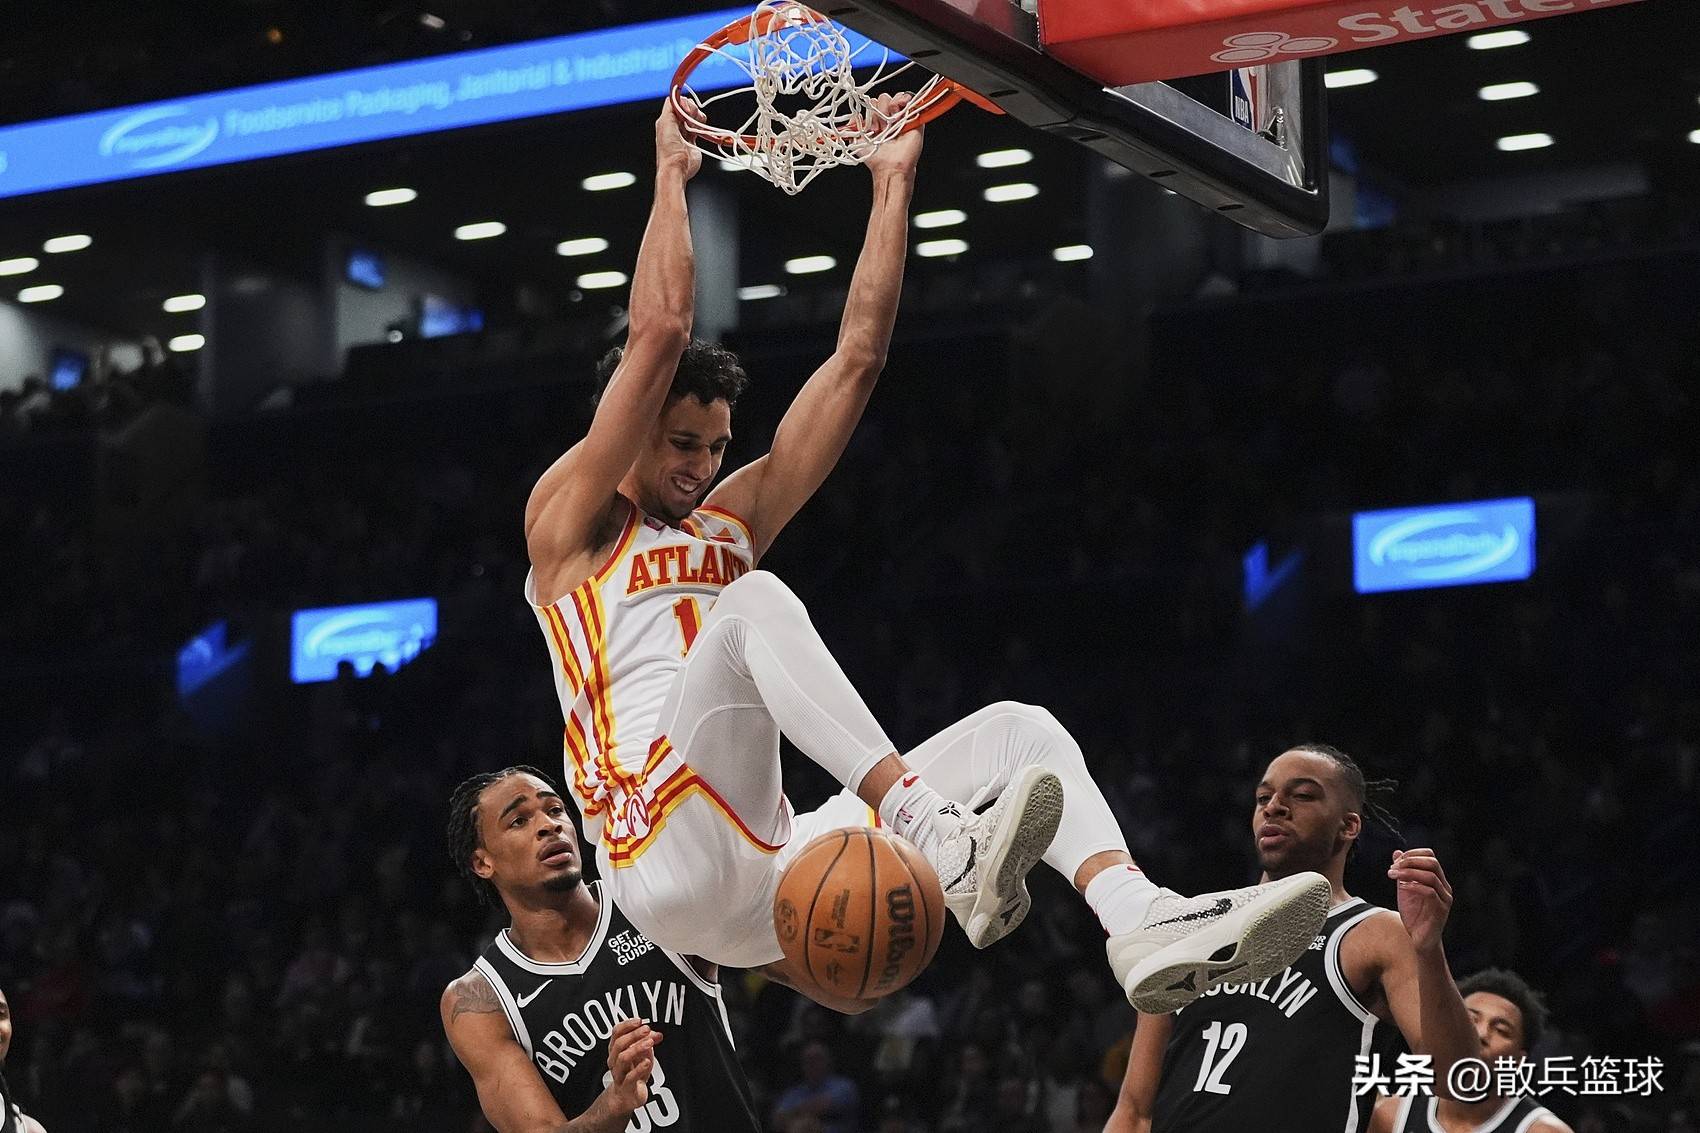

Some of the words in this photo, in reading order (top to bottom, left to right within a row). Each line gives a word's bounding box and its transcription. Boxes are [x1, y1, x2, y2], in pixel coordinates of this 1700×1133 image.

[1234, 95, 1250, 124] NBA
[608, 930, 629, 948] GET
[612, 933, 648, 956] YOUR
[618, 941, 655, 966] GUIDE
[536, 980, 686, 1084] BROOKLYN
[1193, 1021, 1248, 1096] 12
